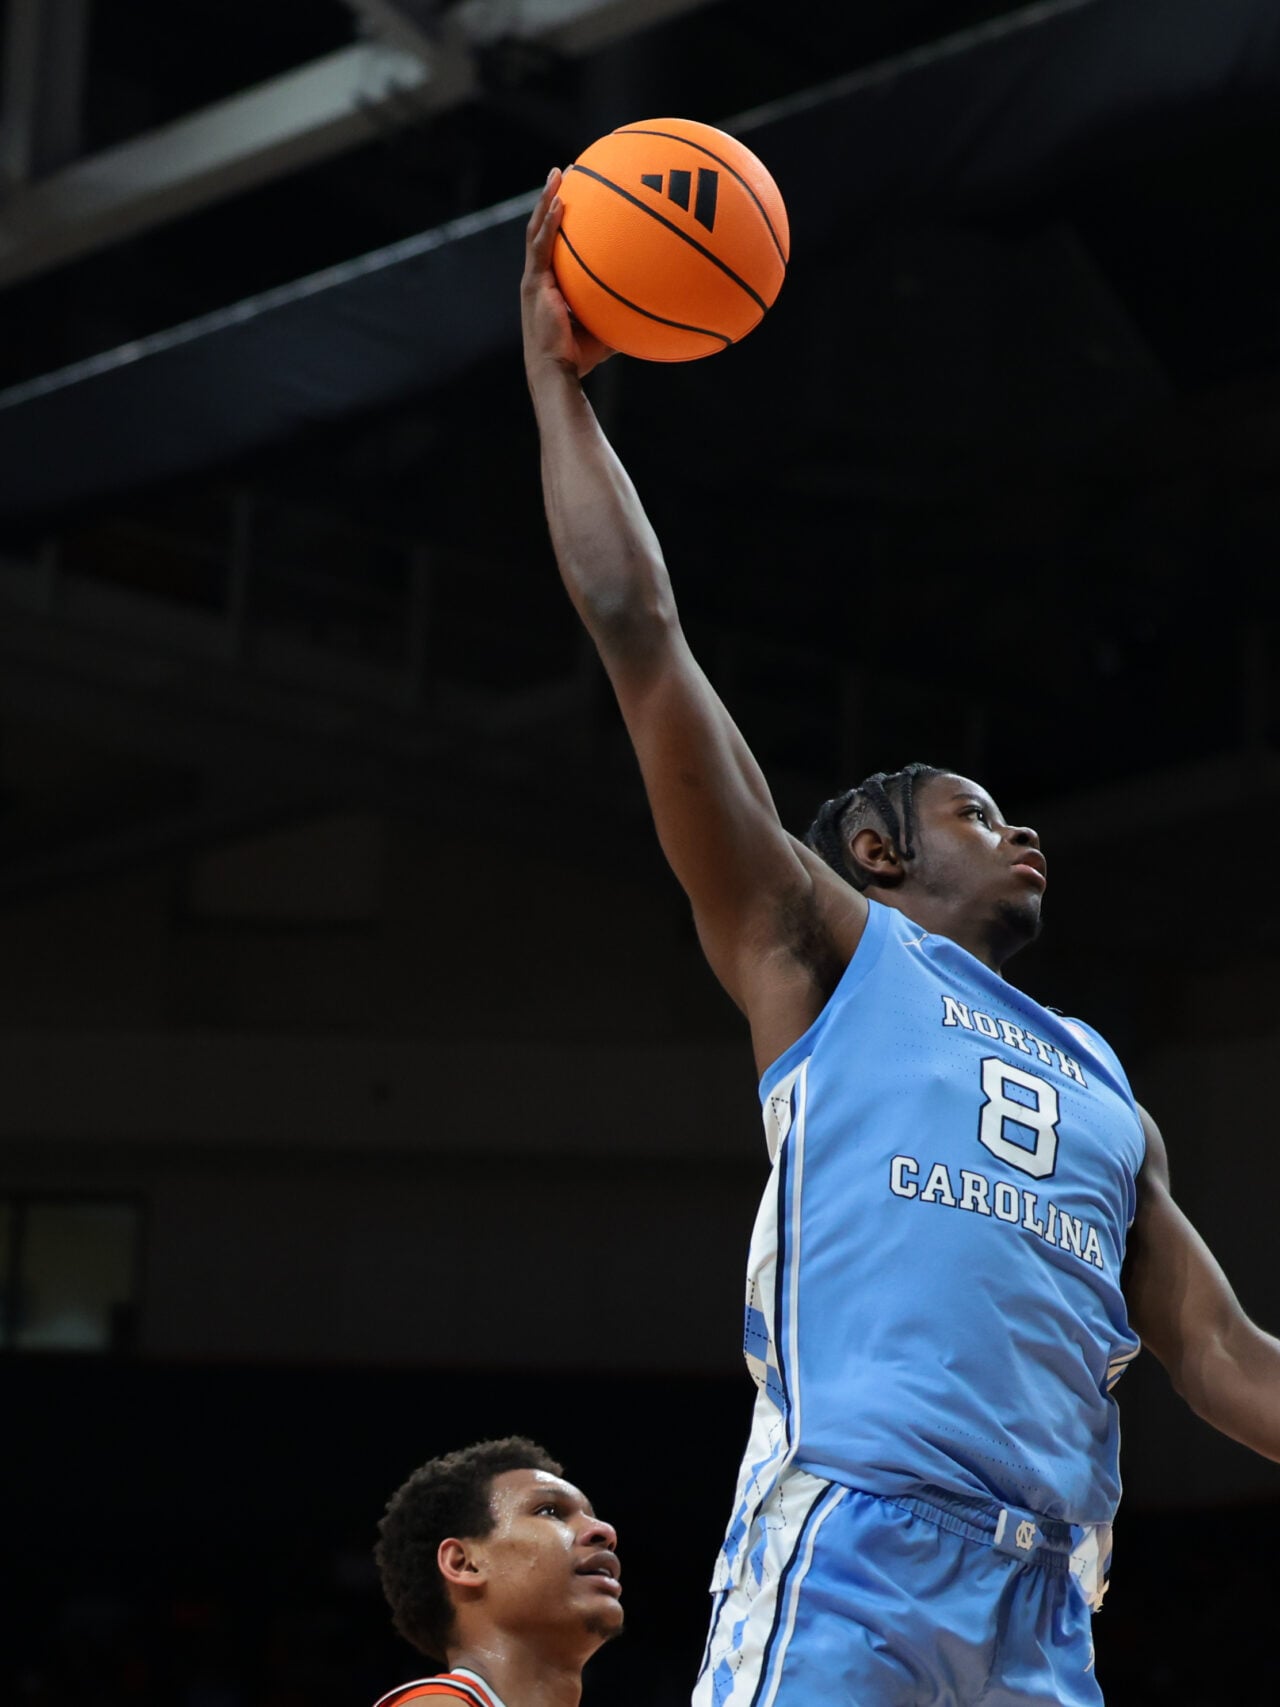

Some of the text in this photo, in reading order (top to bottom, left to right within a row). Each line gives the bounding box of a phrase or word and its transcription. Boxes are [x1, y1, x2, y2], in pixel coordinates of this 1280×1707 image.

[941, 995, 1088, 1088] NORTH
[978, 1056, 1060, 1180] 8
[889, 1155, 1105, 1270] CAROLINA
